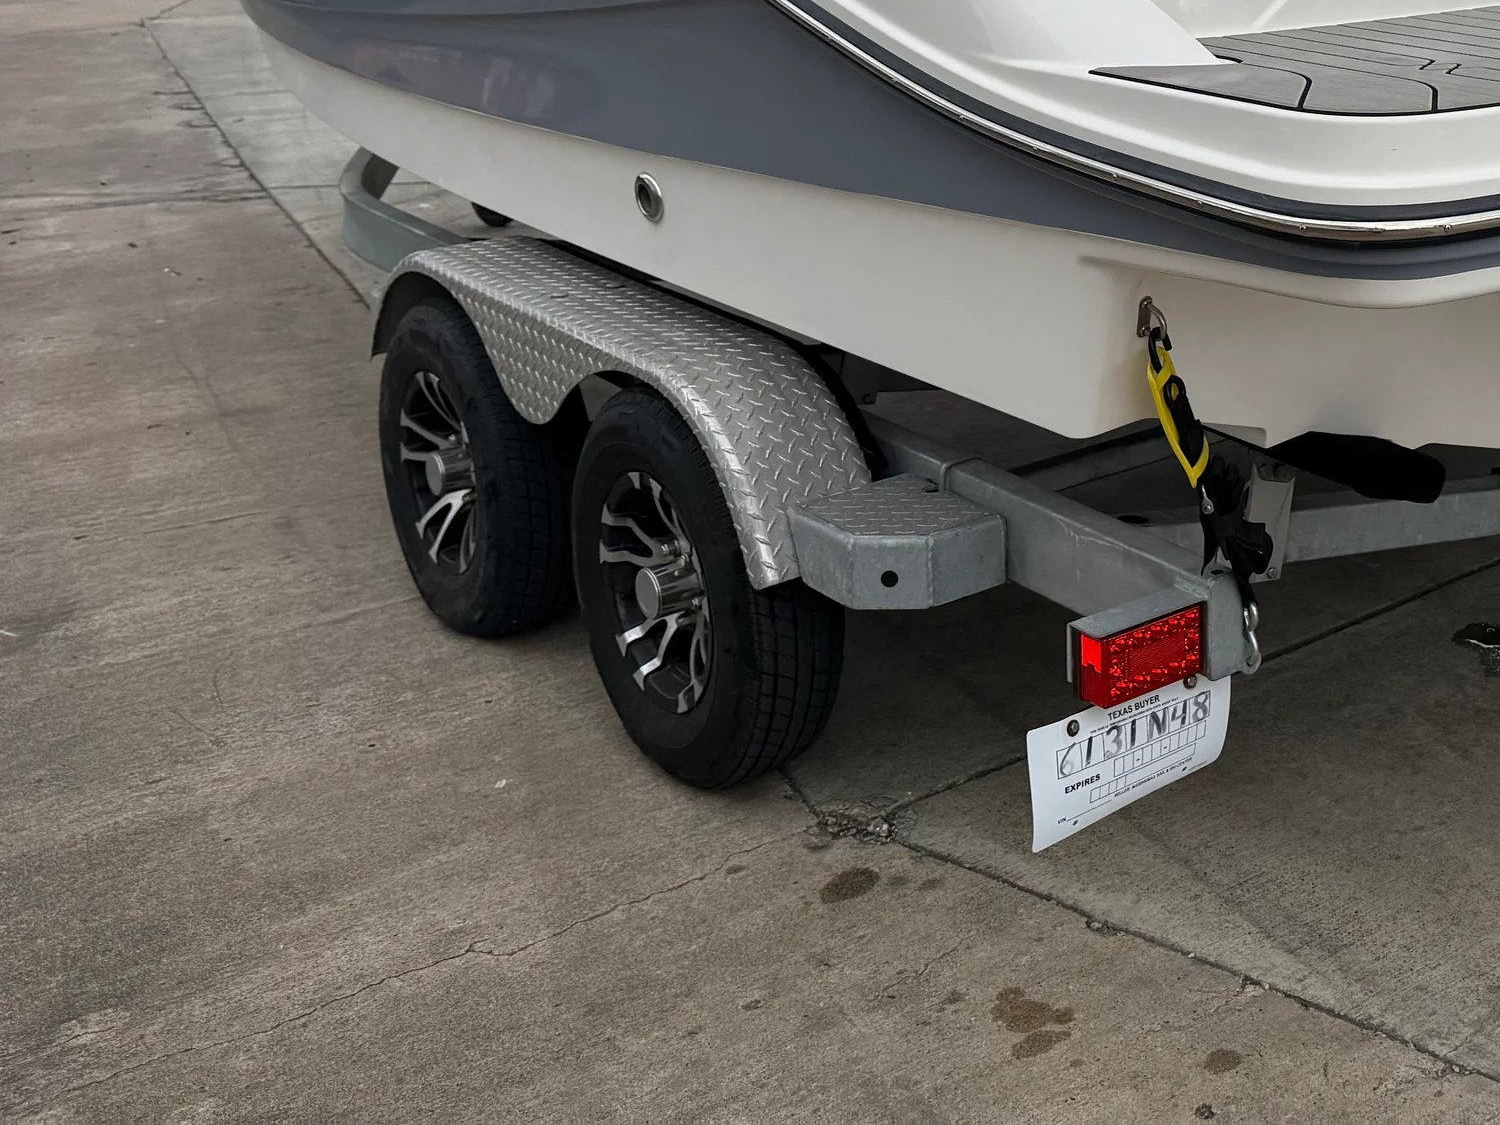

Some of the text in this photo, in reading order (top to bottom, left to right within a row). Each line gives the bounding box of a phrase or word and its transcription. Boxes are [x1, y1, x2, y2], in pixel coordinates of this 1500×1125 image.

[1108, 704, 1133, 721] TEXAS
[1134, 694, 1160, 711] BUYER
[1064, 773, 1101, 794] EXPIRES
